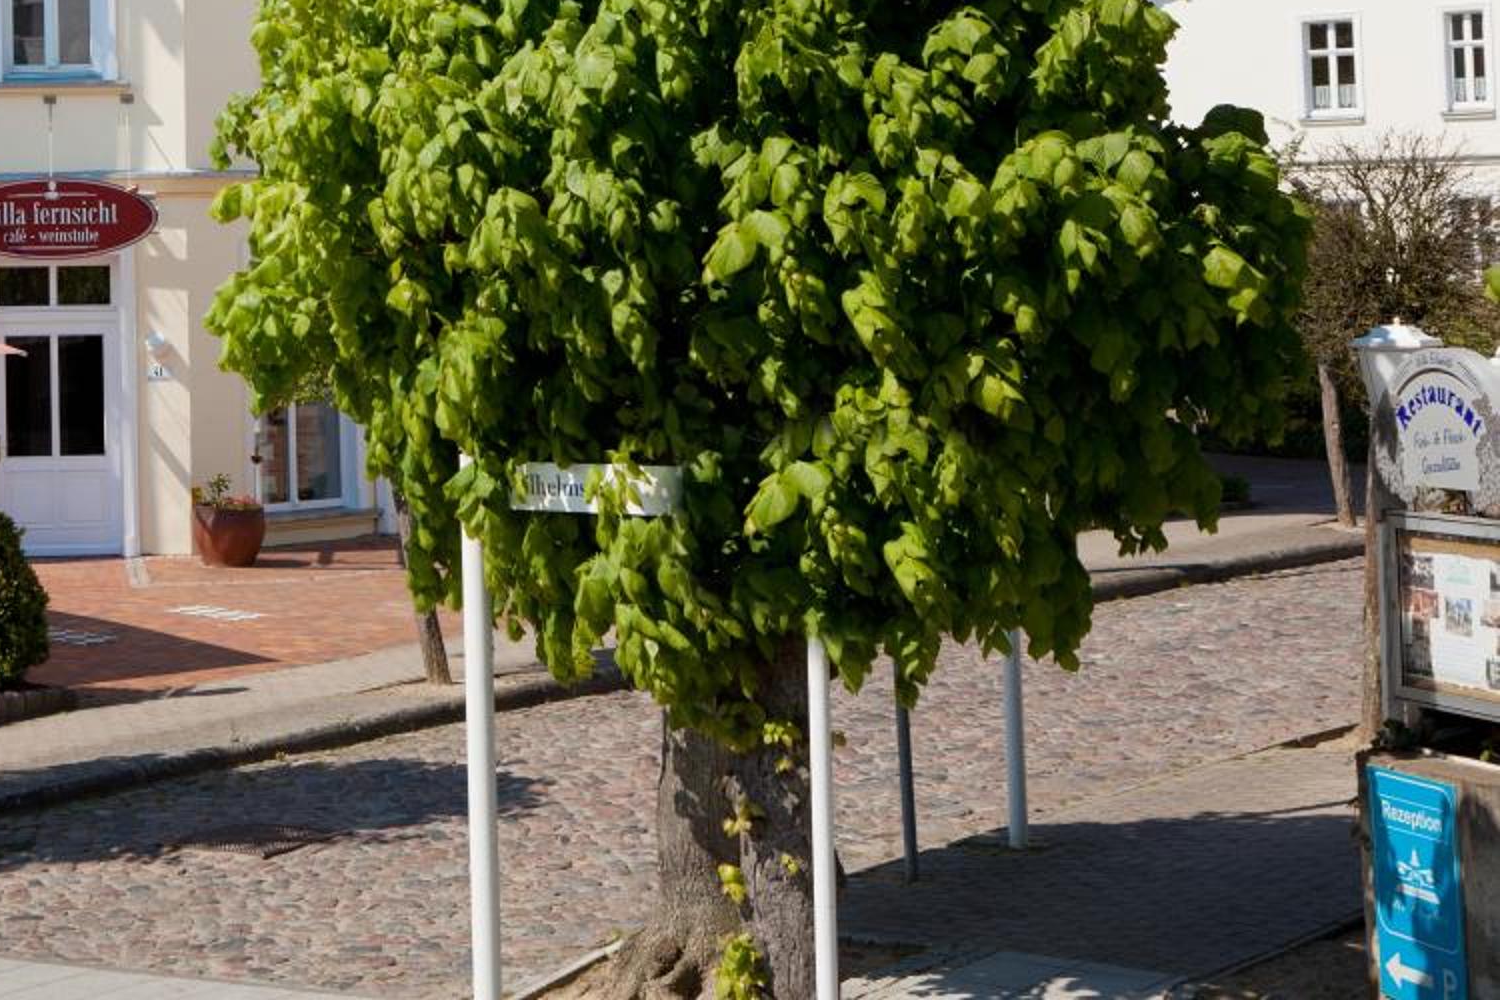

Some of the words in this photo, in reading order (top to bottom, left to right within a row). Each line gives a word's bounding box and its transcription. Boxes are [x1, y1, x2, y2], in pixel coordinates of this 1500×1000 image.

[33, 200, 117, 226] fernsicht
[38, 227, 100, 243] weinstube
[1396, 384, 1481, 437] Restaurant
[1381, 799, 1443, 832] Rezeption
